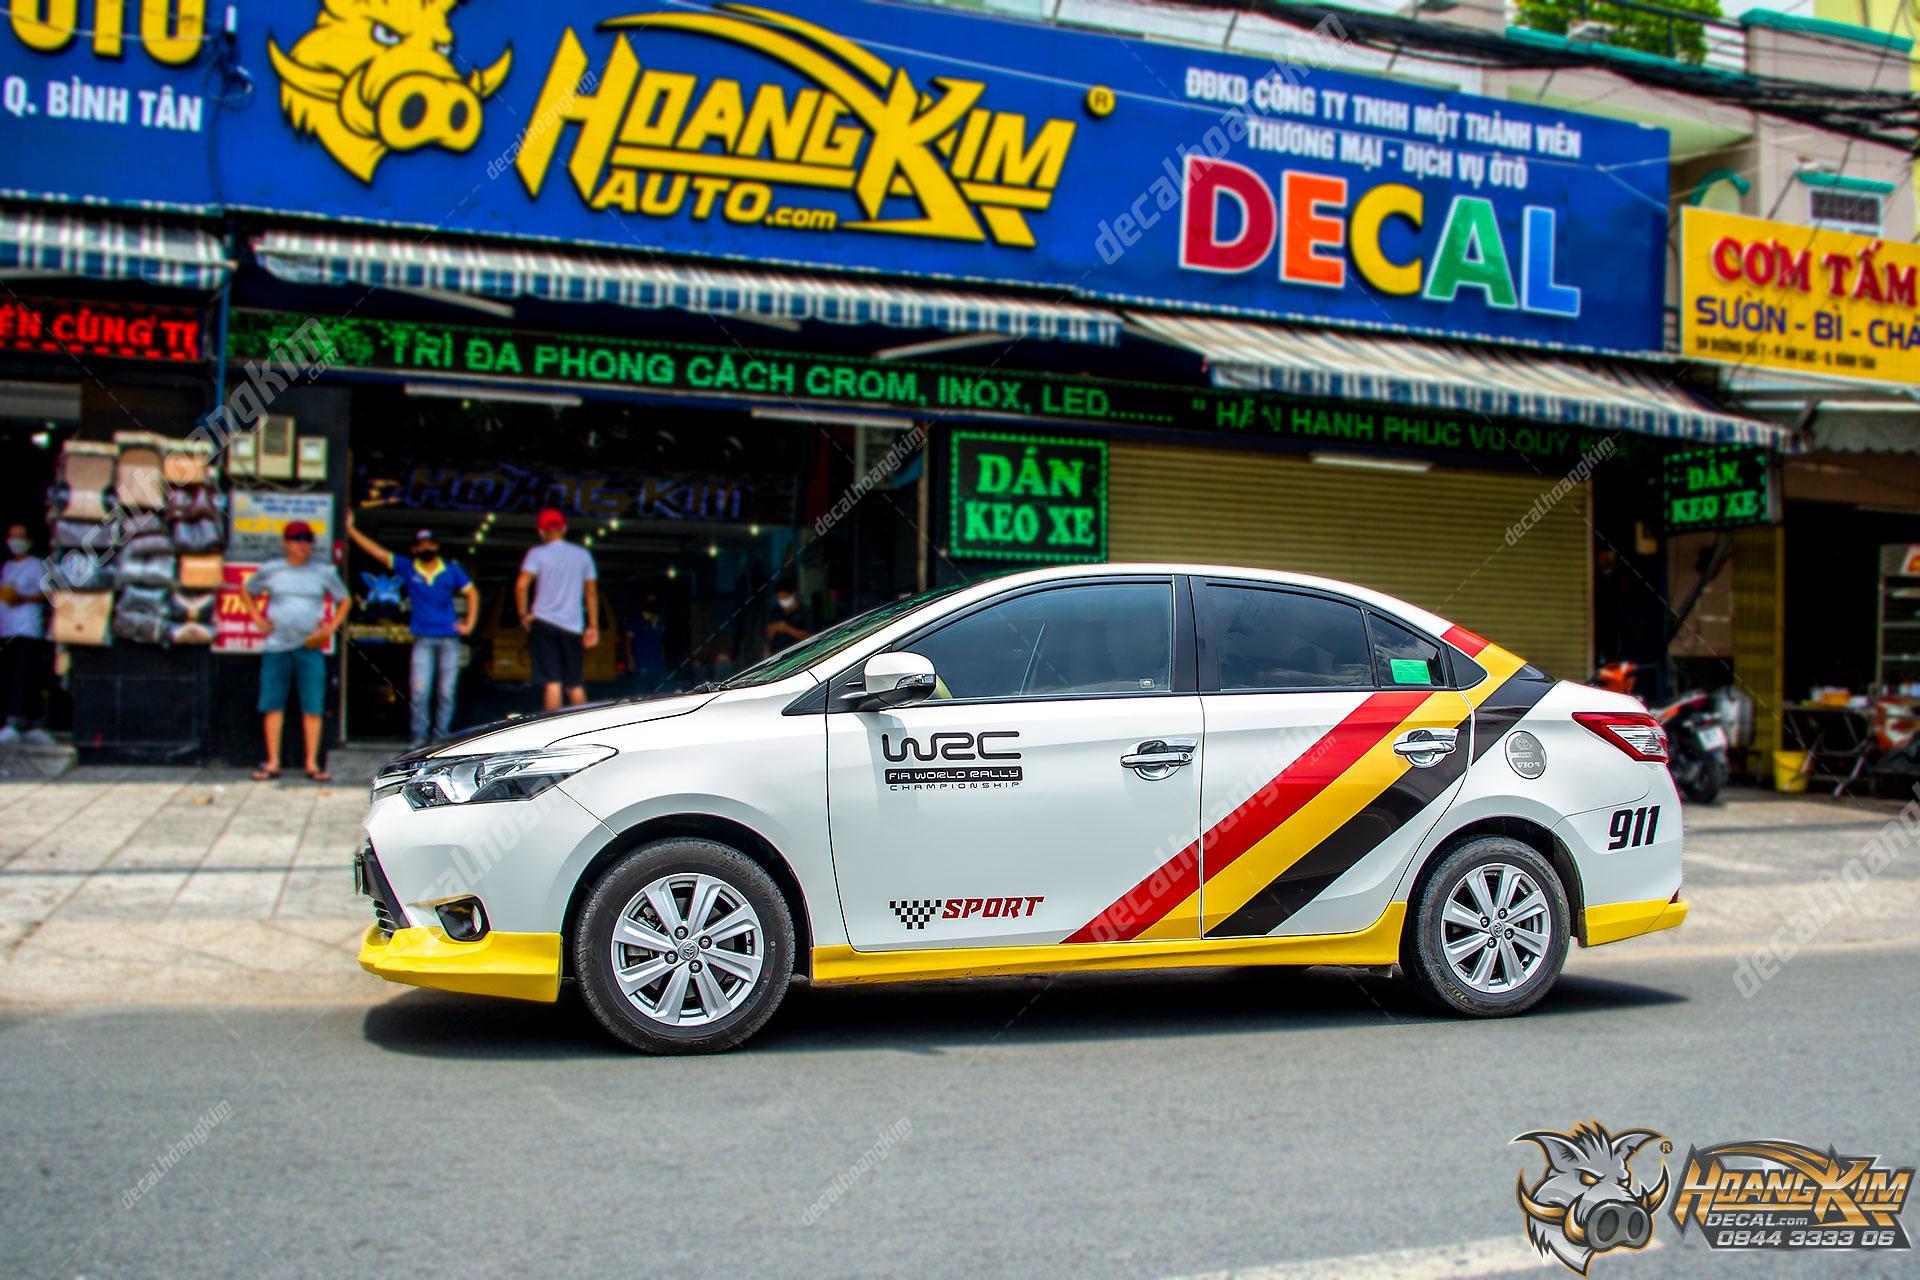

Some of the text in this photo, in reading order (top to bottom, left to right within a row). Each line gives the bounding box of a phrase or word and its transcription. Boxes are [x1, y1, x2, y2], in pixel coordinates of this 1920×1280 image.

[4, 75, 202, 132] Q. BÌNH TÂN
[1254, 74, 1316, 116] CÔNG
[1321, 89, 1348, 121] TY
[1352, 95, 1408, 131] TNHH
[1414, 102, 1461, 143] MỘT
[1465, 110, 1532, 150] THÀNH
[1536, 121, 1581, 159] VIÊN
[1340, 132, 1383, 171] MẠI
[1402, 143, 1453, 180] DỊCH
[1457, 152, 1486, 189] VỤ
[1488, 151, 1528, 190] ÔTÔ
[1178, 154, 1581, 317] DECAL
[1712, 236, 1919, 308] CƠM TẤM
[1696, 291, 1788, 335] SƯỜN
[1814, 303, 1843, 342] BÌ
[534, 344, 676, 385] PHONG
[938, 376, 1033, 415] INOX,
[976, 446, 1085, 498] DÁN
[964, 501, 1096, 547] KEO XE
[882, 730, 1022, 762] WRC
[888, 769, 1019, 780] FIA WORLD RALLY
[889, 781, 1020, 791] CHAMPIONSHIP
[1607, 804, 1661, 850] 911
[941, 896, 1045, 918] SPORT
